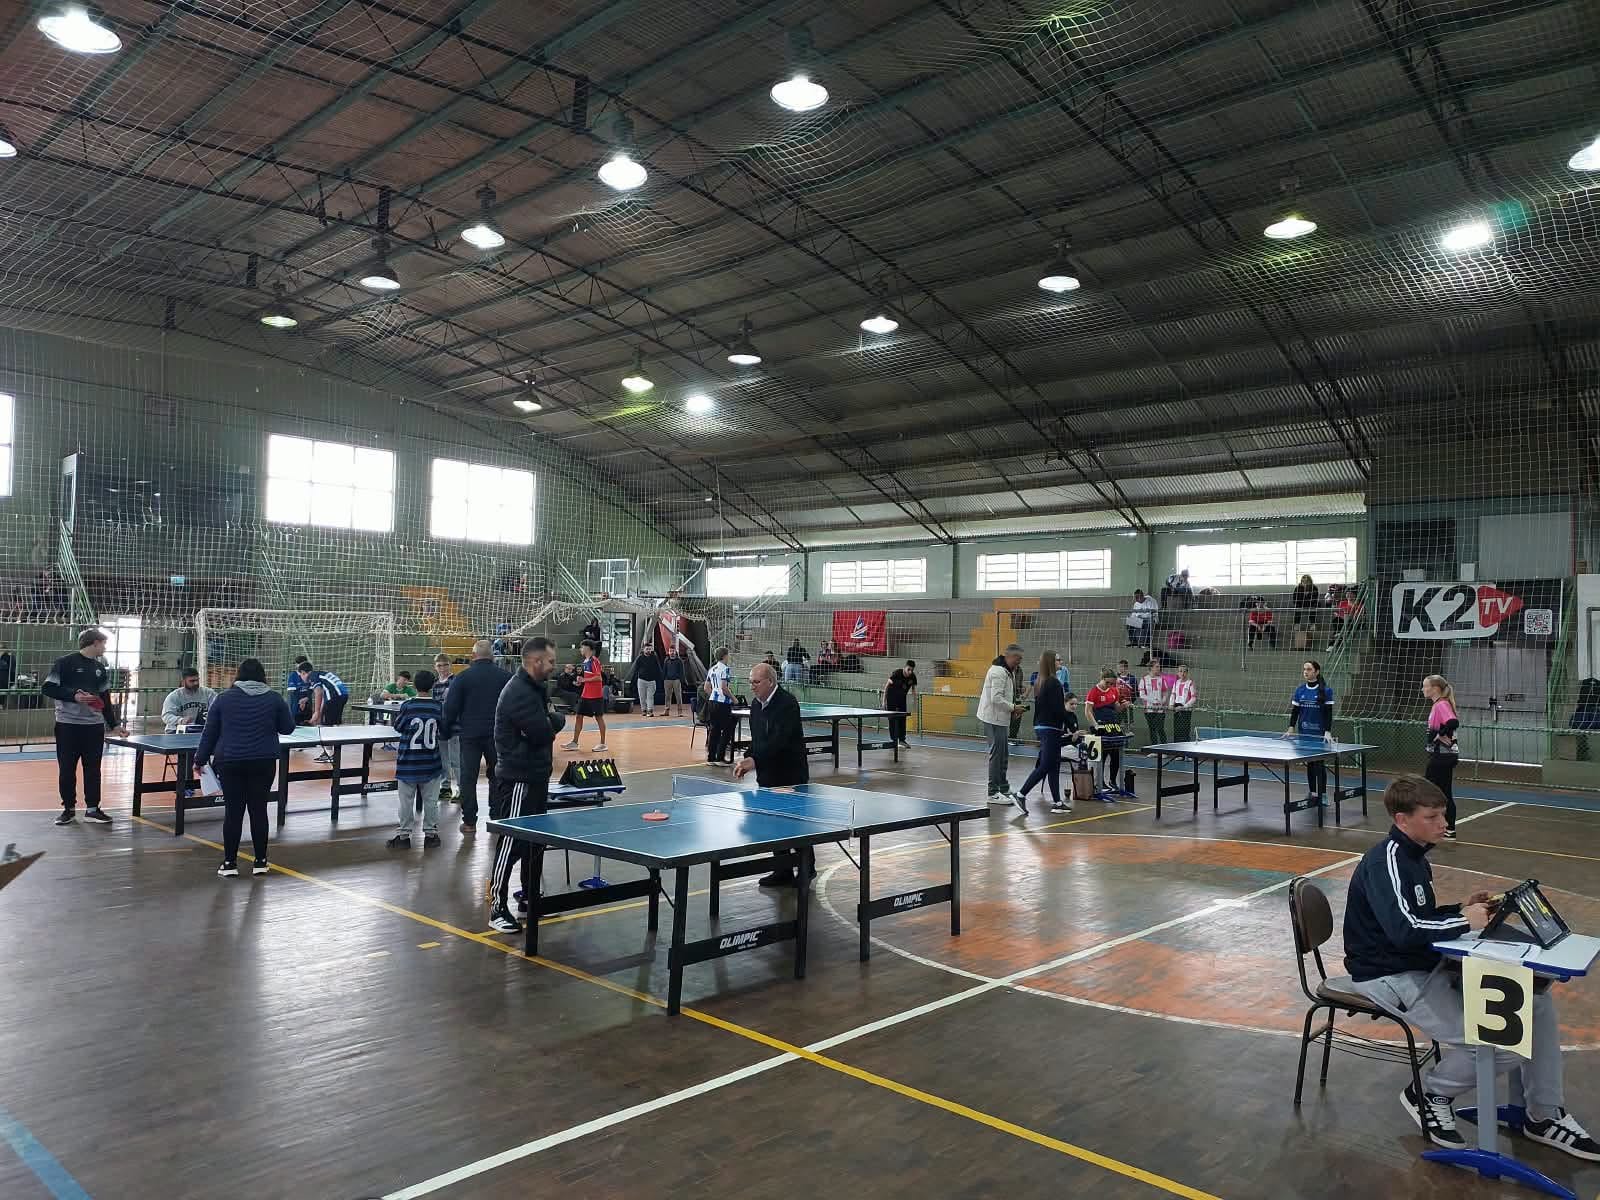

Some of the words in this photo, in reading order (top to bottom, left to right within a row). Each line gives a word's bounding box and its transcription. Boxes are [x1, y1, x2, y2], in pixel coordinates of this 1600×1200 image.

[1398, 585, 1476, 634] K2
[1481, 597, 1513, 615] TV
[410, 717, 437, 750] 20
[1088, 740, 1098, 761] 6
[719, 930, 761, 950] OLIMPIC
[1477, 974, 1525, 1047] 3
